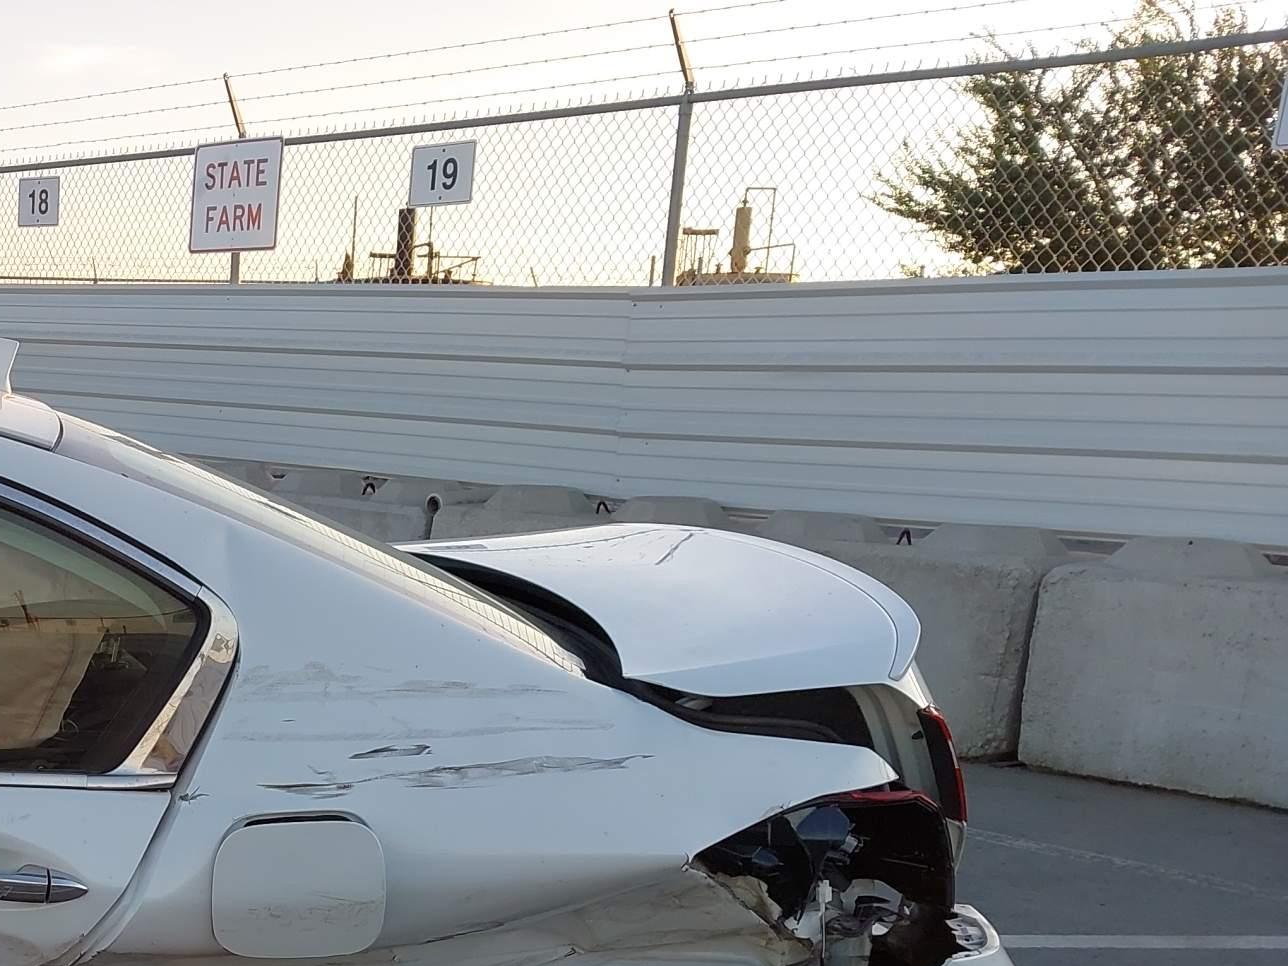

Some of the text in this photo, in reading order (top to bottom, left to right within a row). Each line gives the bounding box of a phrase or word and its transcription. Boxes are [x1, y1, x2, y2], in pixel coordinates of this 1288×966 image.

[205, 158, 269, 190] STATE
[427, 157, 458, 191] 19
[28, 188, 49, 215] 18
[205, 203, 262, 233] FARM
